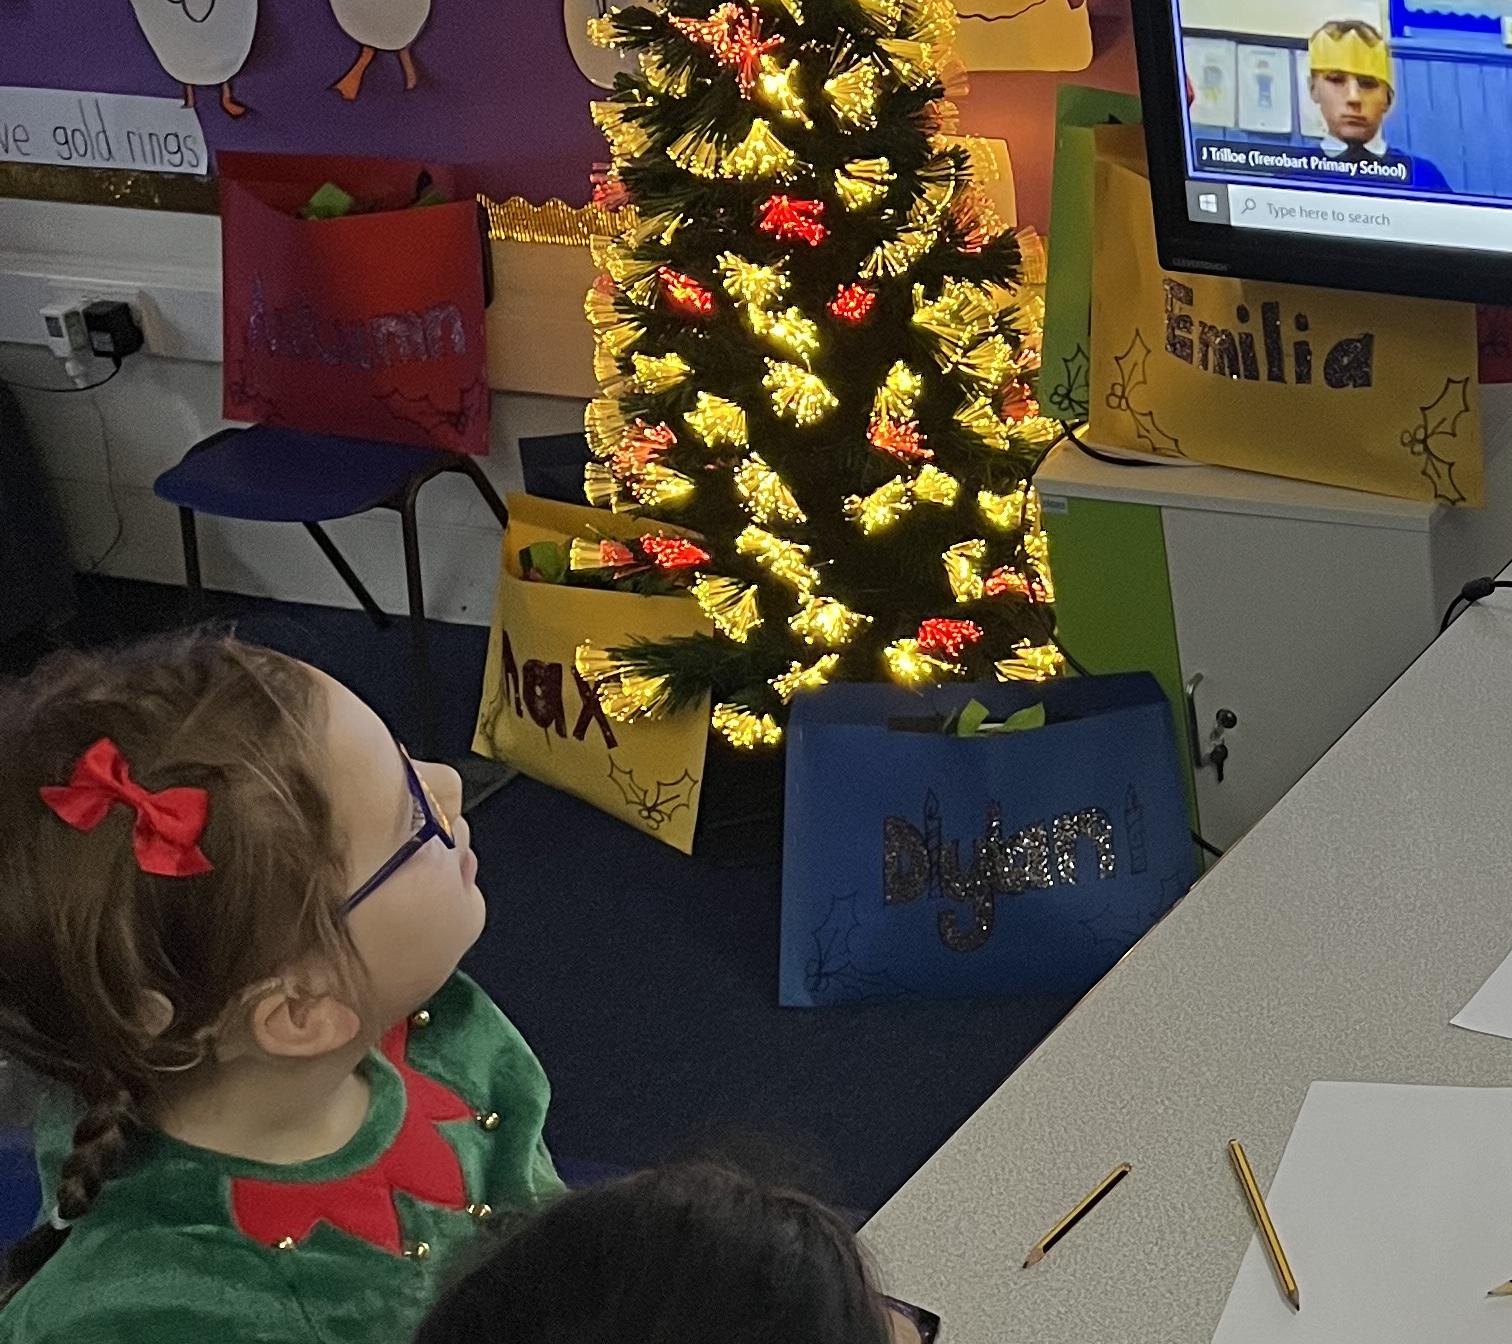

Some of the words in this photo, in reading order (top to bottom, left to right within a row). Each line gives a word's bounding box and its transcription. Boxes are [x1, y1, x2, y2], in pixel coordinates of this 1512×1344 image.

[53, 99, 115, 162] gold
[126, 129, 200, 168] rings
[1249, 150, 1308, 170] (Trerobart
[1311, 157, 1358, 177] Primary
[1360, 161, 1407, 181] School)
[1266, 203, 1296, 219] Type
[1299, 206, 1328, 220] here
[1332, 208, 1344, 222] to
[1349, 211, 1390, 226] search
[1163, 276, 1375, 389] Emilia
[883, 800, 1116, 952] Dylan
